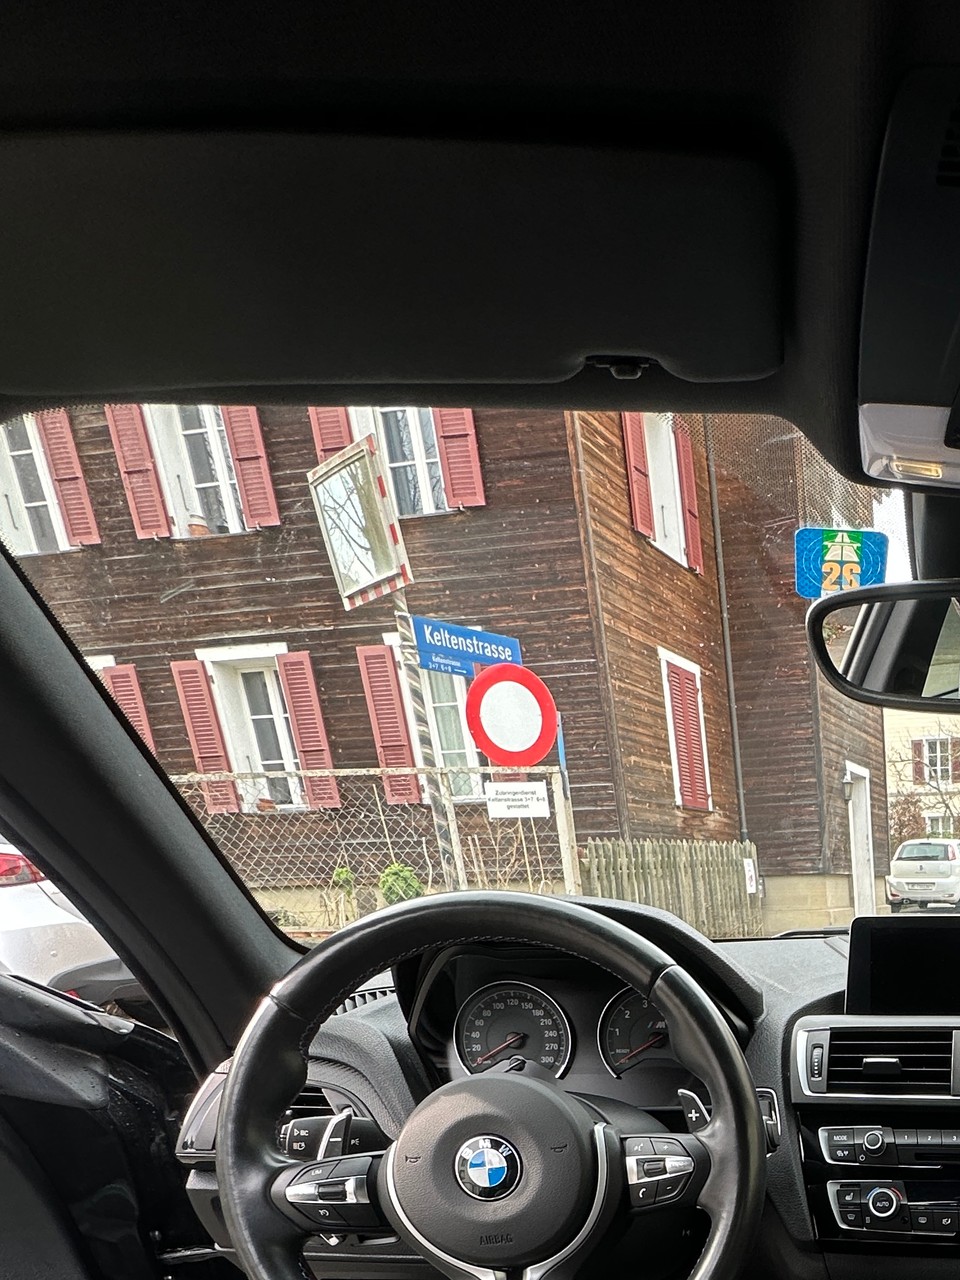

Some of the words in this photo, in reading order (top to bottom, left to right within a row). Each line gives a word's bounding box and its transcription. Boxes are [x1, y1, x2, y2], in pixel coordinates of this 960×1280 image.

[423, 624, 513, 661] Keltenstrasse
[492, 1002, 505, 1010] 100
[521, 1002, 533, 1010] 150
[642, 1000, 648, 1008] 3
[482, 1009, 492, 1017] 80
[532, 1009, 544, 1017] 180
[624, 1010, 631, 1019] 2
[475, 1019, 484, 1027] 60
[471, 1031, 480, 1039] 40
[544, 1030, 557, 1038] 240
[615, 1028, 620, 1036] 1
[472, 1044, 481, 1052] 20
[545, 1043, 558, 1051] 270
[540, 1056, 554, 1064] 300
[462, 1138, 512, 1160] BMW
[479, 1233, 514, 1246] AIRBAG
